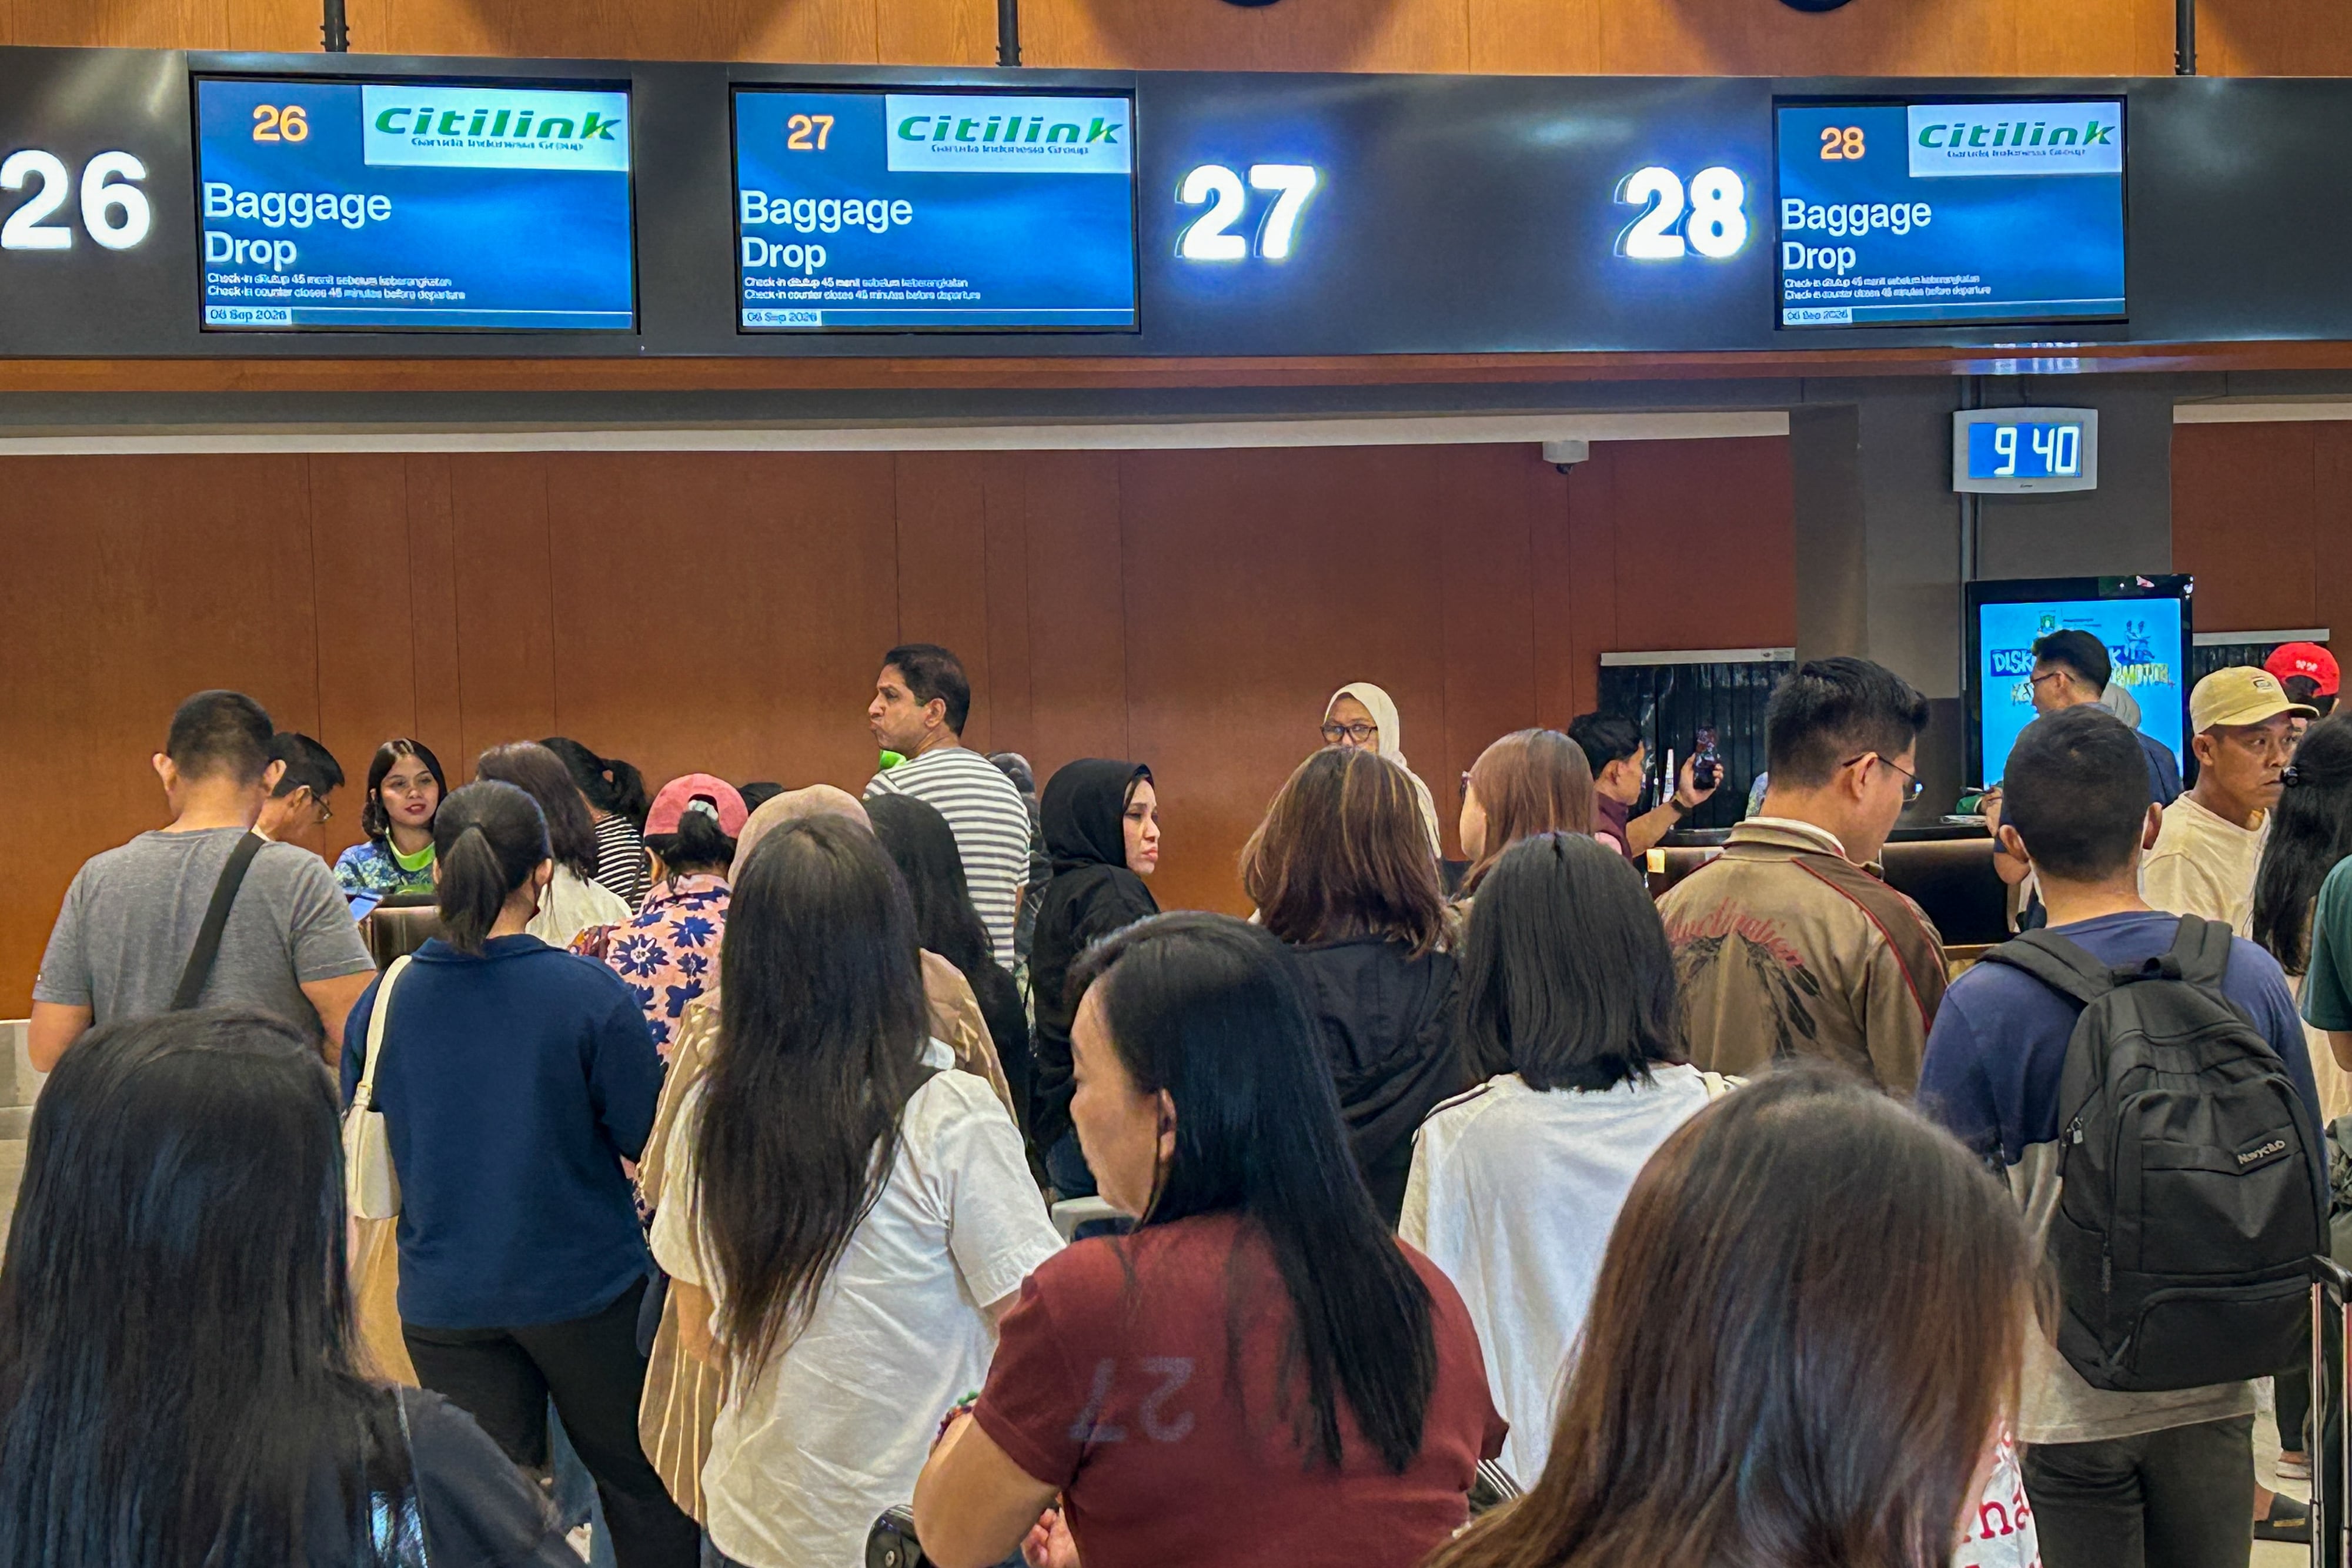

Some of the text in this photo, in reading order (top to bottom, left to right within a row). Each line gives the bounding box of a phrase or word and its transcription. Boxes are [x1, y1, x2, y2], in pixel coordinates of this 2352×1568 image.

[253, 105, 308, 142] 26
[375, 107, 621, 141] Citilink
[787, 115, 834, 150] 27
[898, 115, 1122, 143] Citilink
[1820, 126, 1865, 160] 28
[1919, 121, 2116, 148] Citilink
[0, 150, 151, 249] 26
[203, 182, 392, 229] Baggage
[740, 189, 913, 234] Baggage
[1175, 164, 1317, 259] 27
[1614, 166, 1747, 259] 28
[1782, 198, 1932, 237] Baggage
[205, 230, 298, 272] Drop
[741, 236, 827, 275] Drop
[1782, 241, 1856, 276] Drop
[1994, 426, 2079, 475] 9 40
